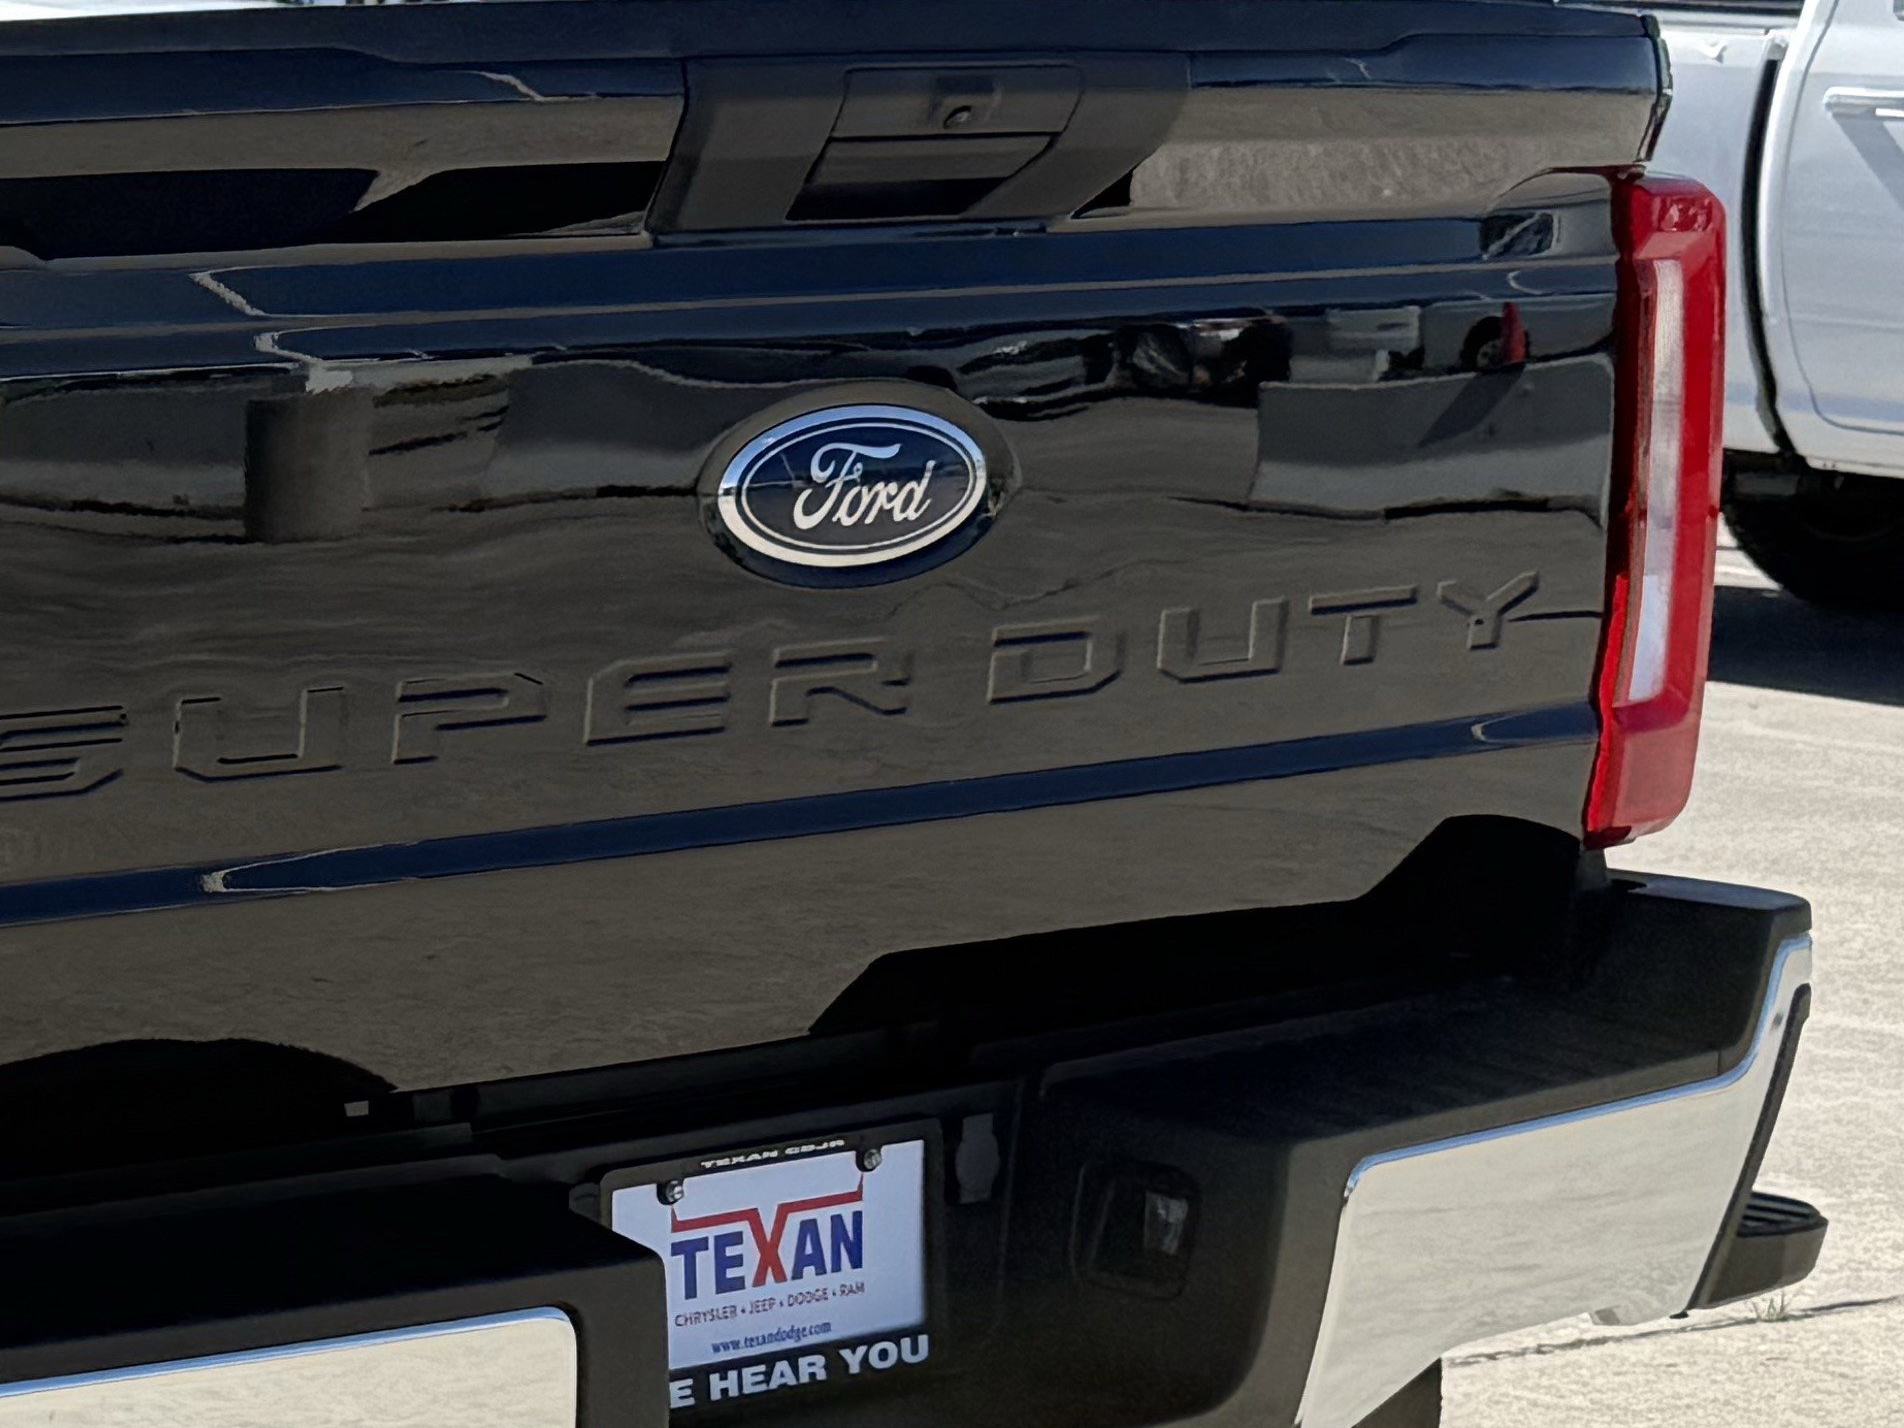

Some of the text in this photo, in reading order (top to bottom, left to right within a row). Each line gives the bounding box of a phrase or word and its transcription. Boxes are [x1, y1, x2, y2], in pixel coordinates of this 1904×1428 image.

[793, 442, 935, 529] Ford
[987, 572, 1540, 704] DUTY
[700, 1149, 779, 1169] TEXAN
[671, 1202, 864, 1300] TEXAN
[675, 1282, 865, 1327] CHRYSLER JEEP DODGE RAM
[711, 1322, 832, 1354] www.texandodge.com
[709, 1354, 827, 1401] HEAR
[838, 1334, 930, 1376] YOU
